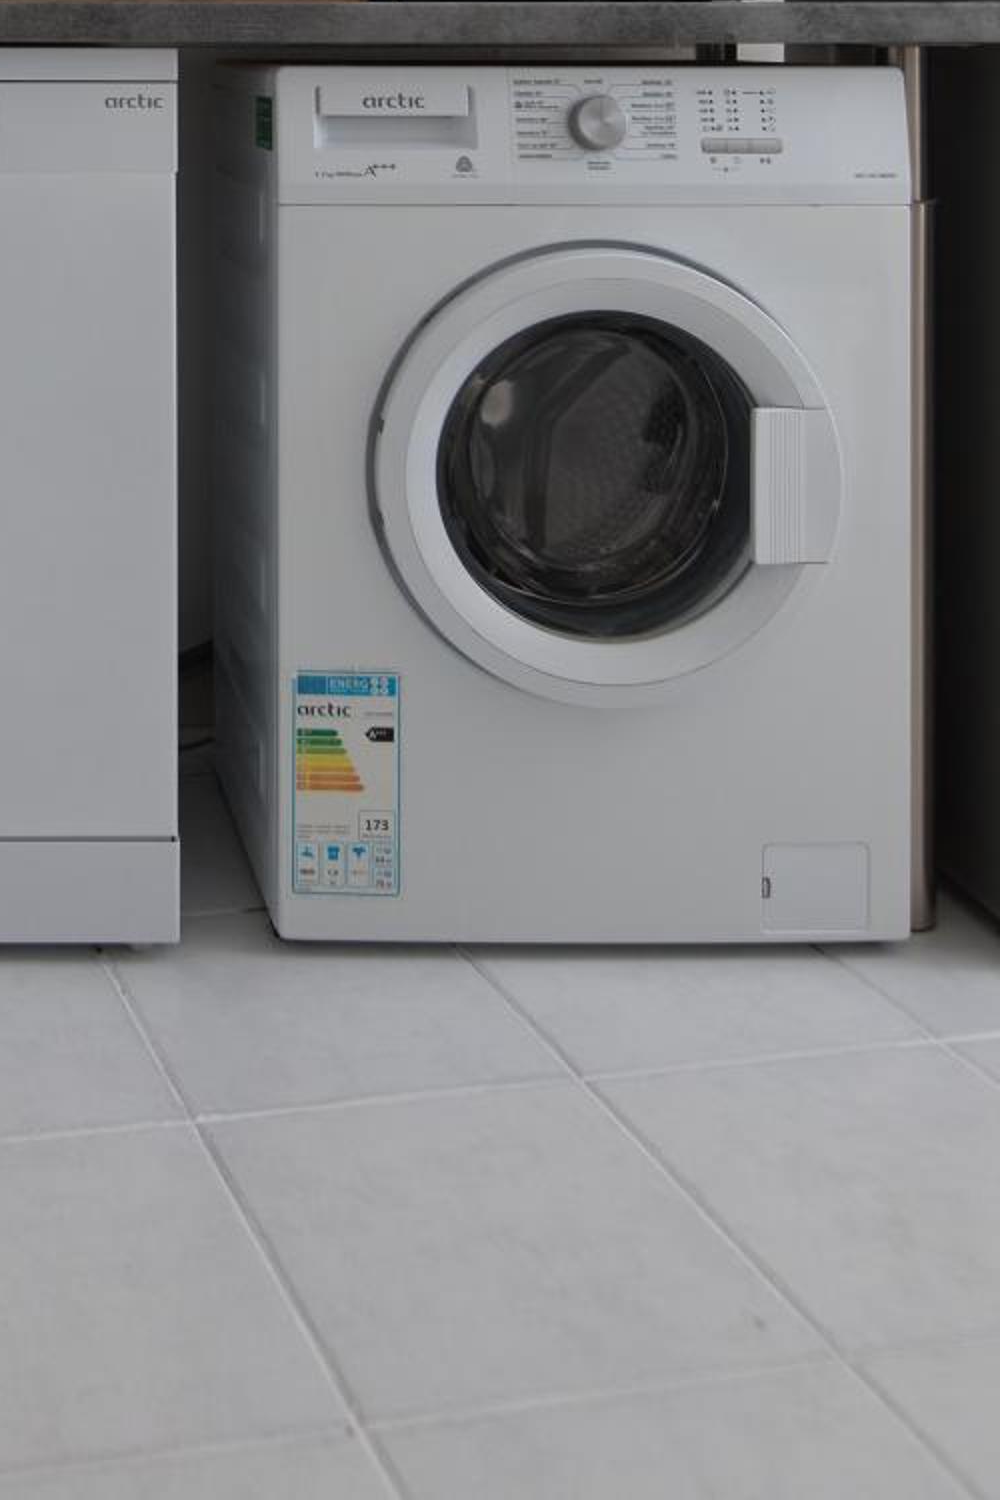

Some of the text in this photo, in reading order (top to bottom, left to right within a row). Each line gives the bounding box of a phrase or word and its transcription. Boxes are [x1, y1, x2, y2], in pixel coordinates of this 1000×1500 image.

[105, 94, 165, 109] arctic
[362, 93, 425, 109] arctic
[297, 702, 351, 717] arctic
[365, 819, 389, 831] 173
